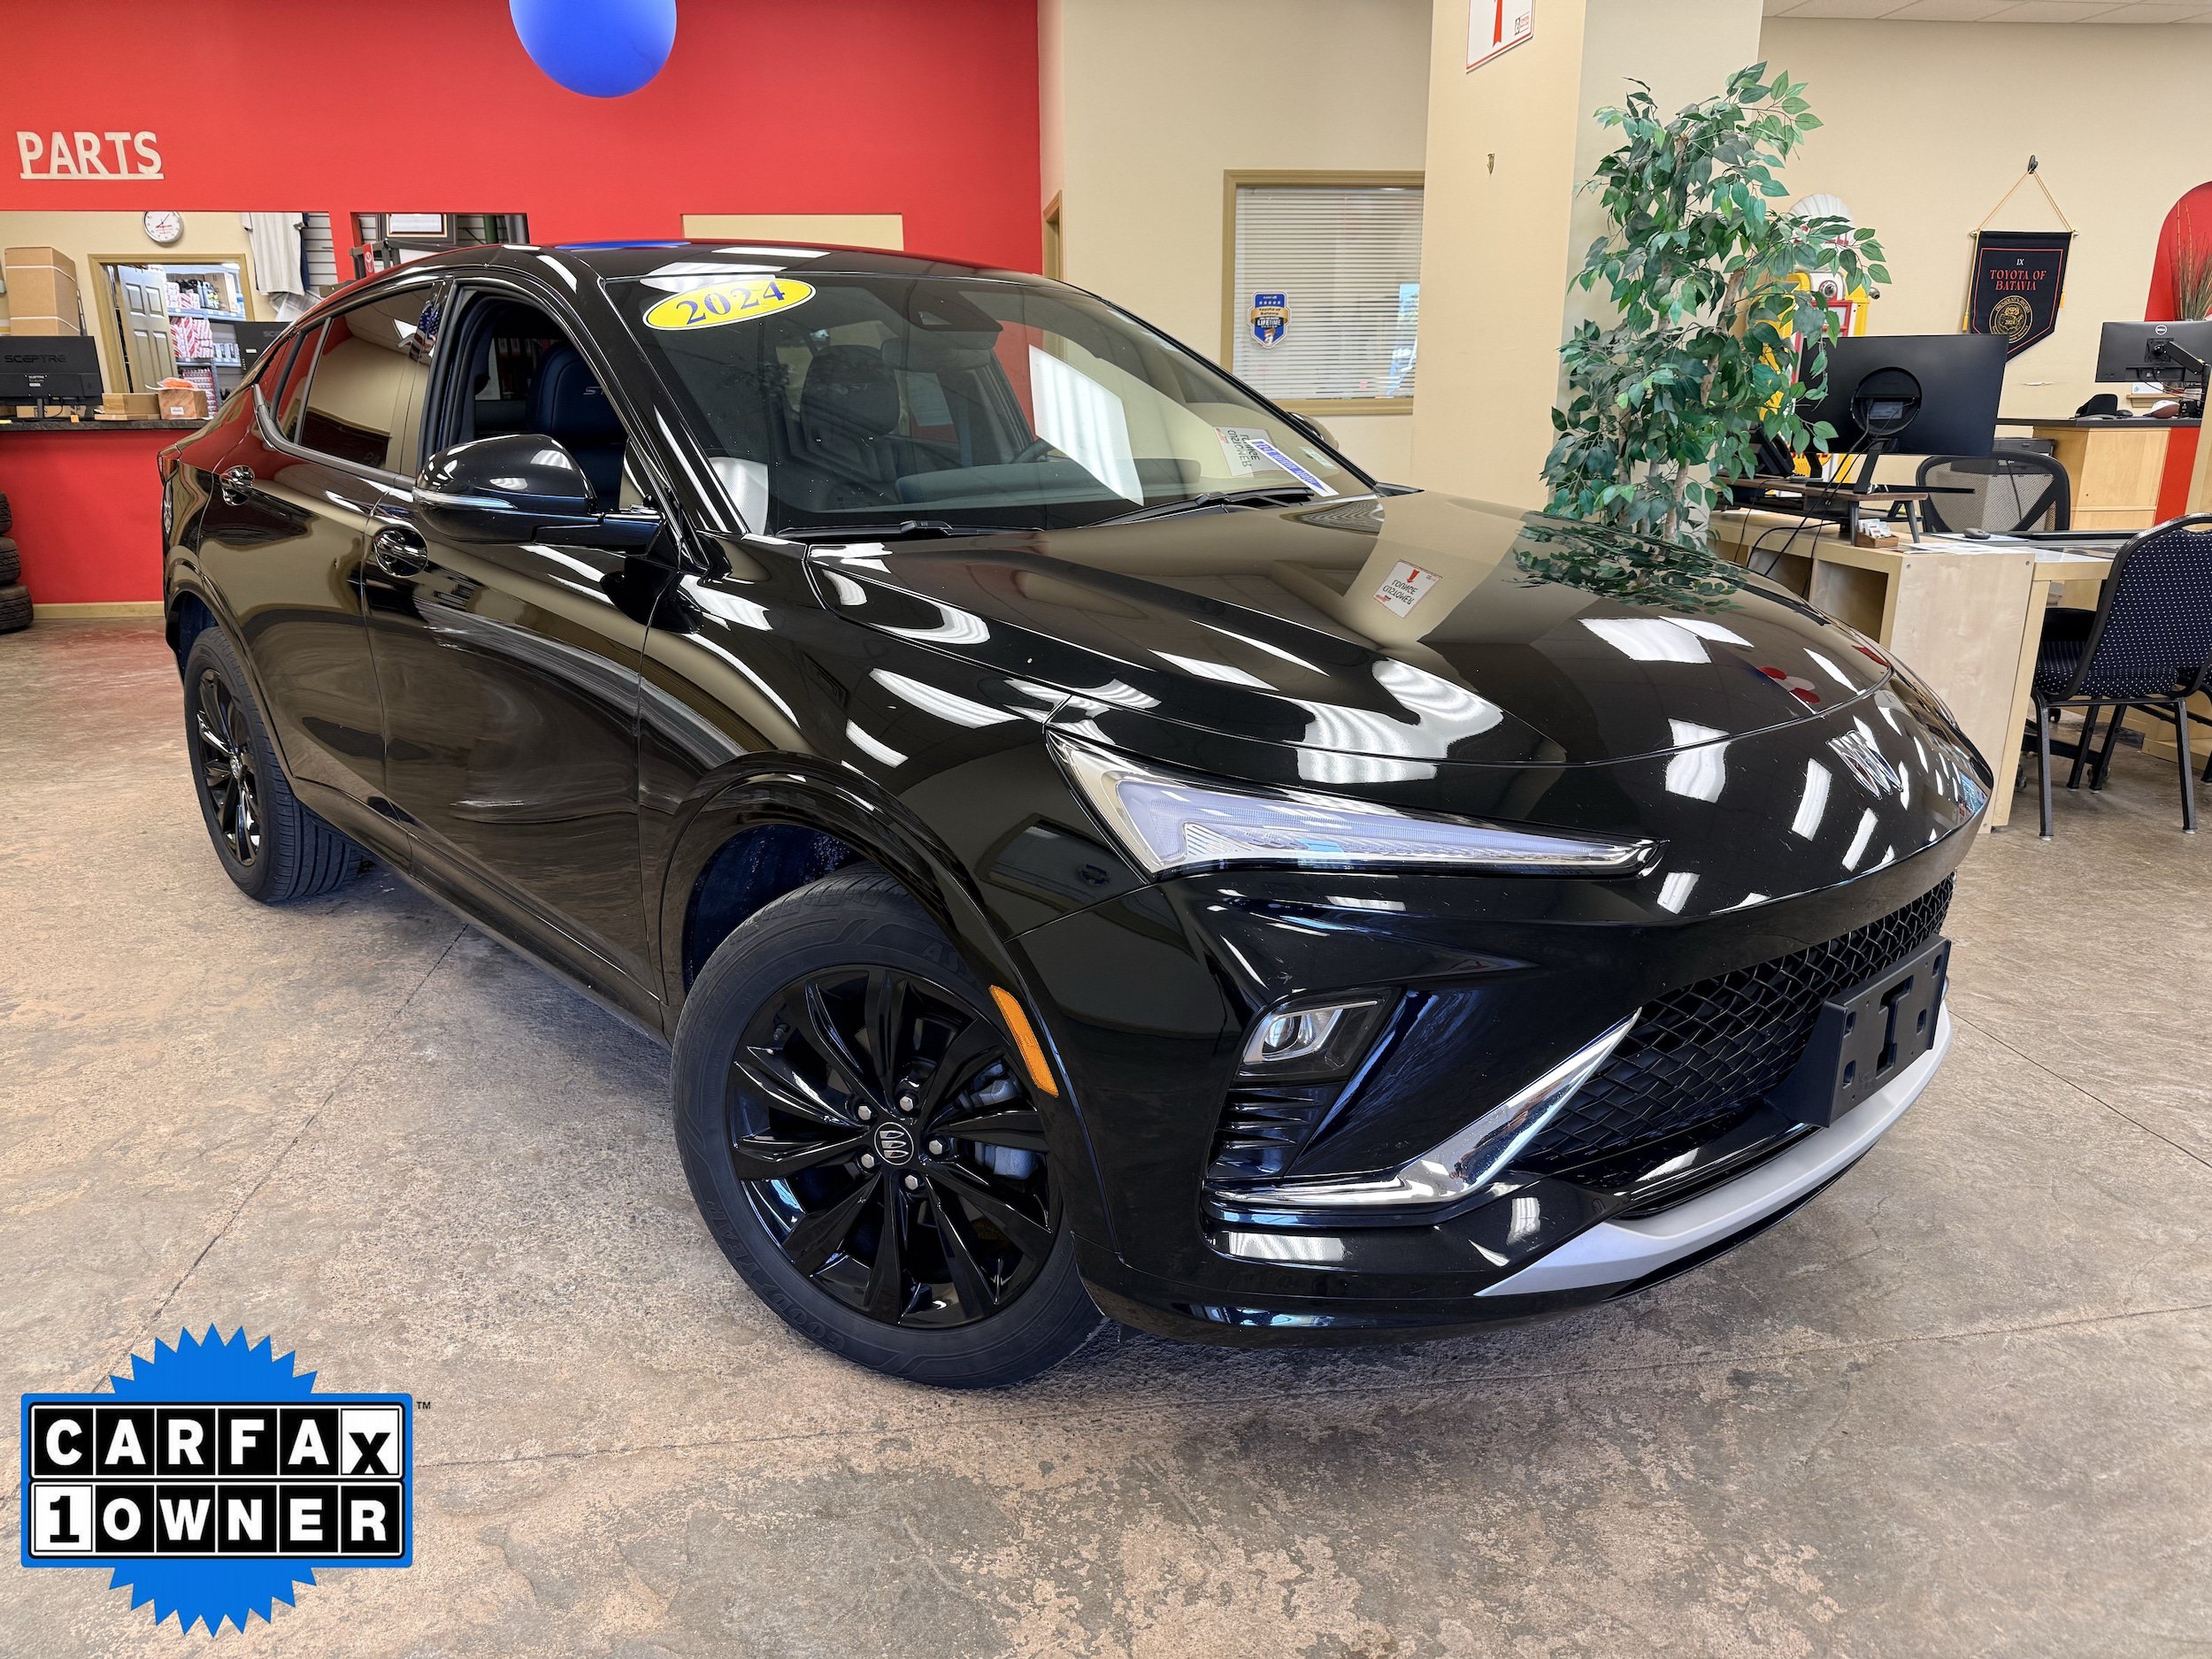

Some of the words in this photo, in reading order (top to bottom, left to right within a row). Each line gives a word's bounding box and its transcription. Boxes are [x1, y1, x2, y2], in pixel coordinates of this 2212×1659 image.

[16, 130, 163, 176] PARTS
[1989, 270, 2029, 280] TOYOTA
[2032, 270, 2047, 280] OF
[1995, 280, 2037, 291] BATAVIA
[676, 280, 786, 325] 2024
